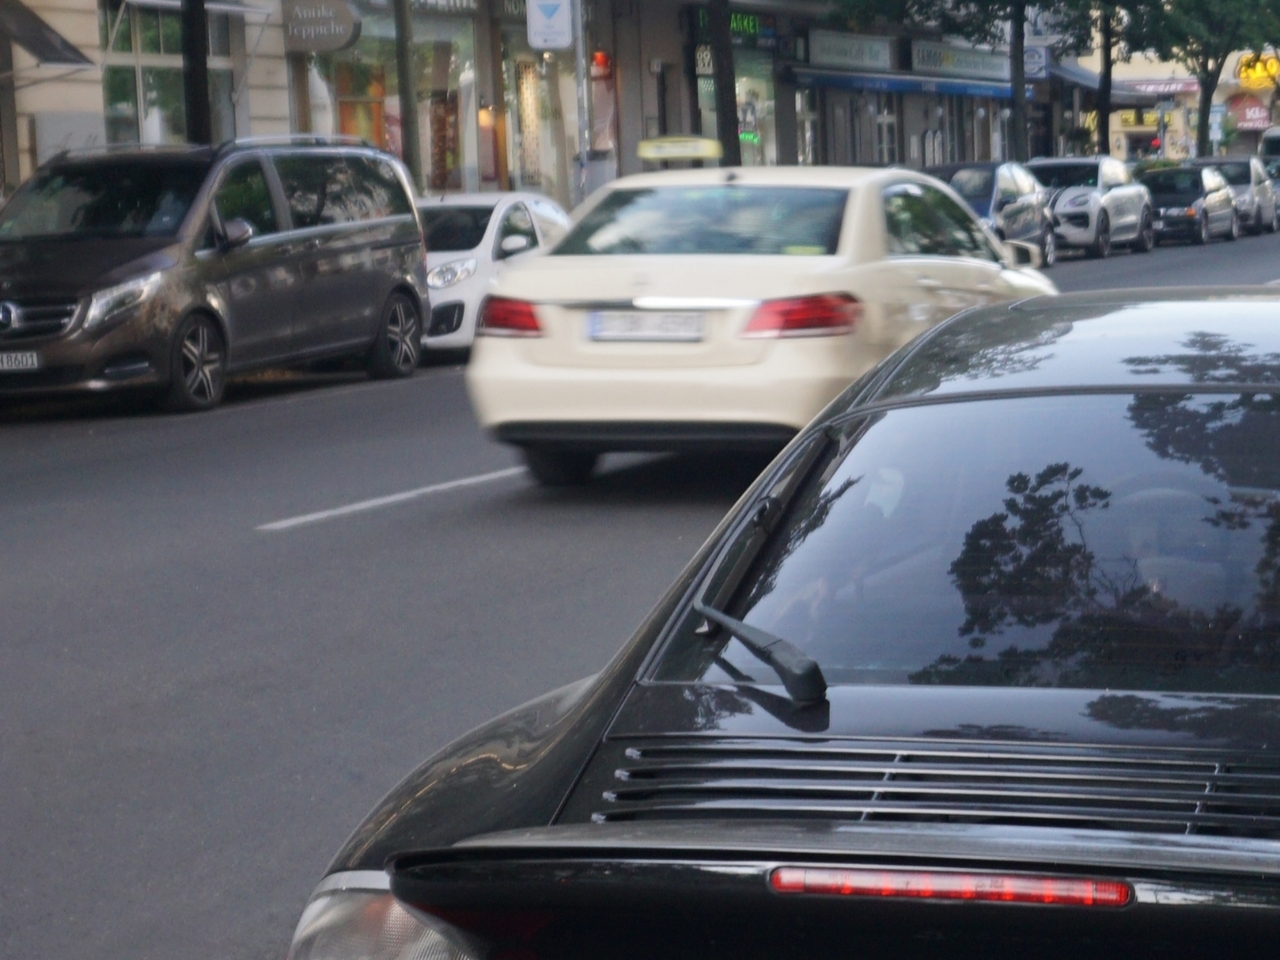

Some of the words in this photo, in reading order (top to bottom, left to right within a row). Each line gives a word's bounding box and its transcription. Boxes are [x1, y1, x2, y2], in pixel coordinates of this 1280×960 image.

[292, 5, 336, 18] Antike
[287, 22, 346, 39] Teppiche
[7, 354, 36, 368] 8601
